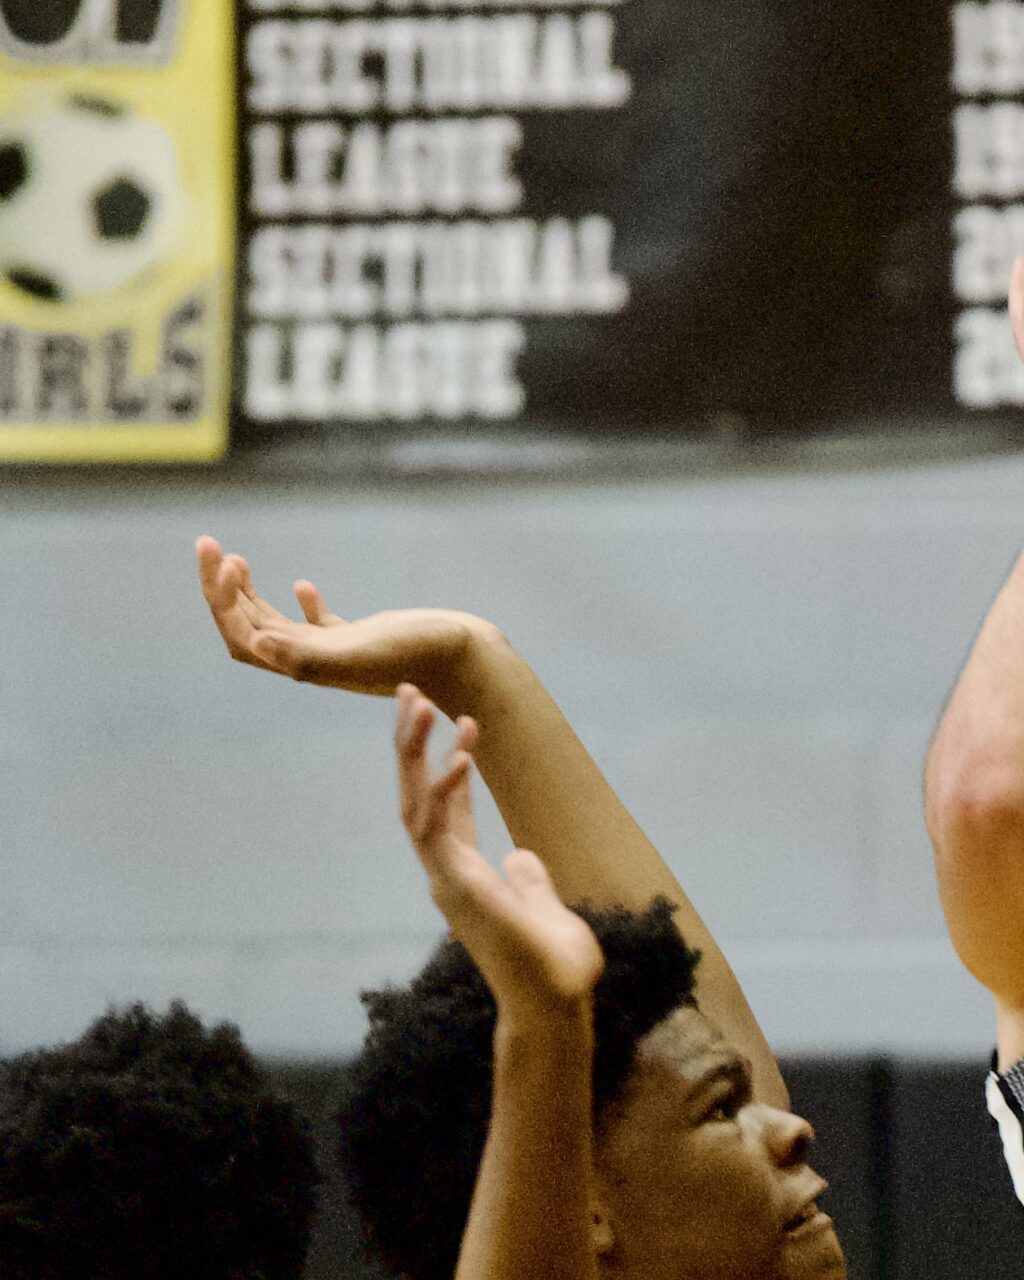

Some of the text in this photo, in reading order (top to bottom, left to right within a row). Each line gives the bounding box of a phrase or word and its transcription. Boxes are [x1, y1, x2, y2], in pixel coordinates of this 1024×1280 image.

[245, 12, 632, 110] SECTIONAL
[246, 114, 525, 217] LEAGUE
[246, 214, 632, 318] SECTIONAL
[0, 298, 207, 422] IRLS
[245, 316, 527, 421] LEAGUE
